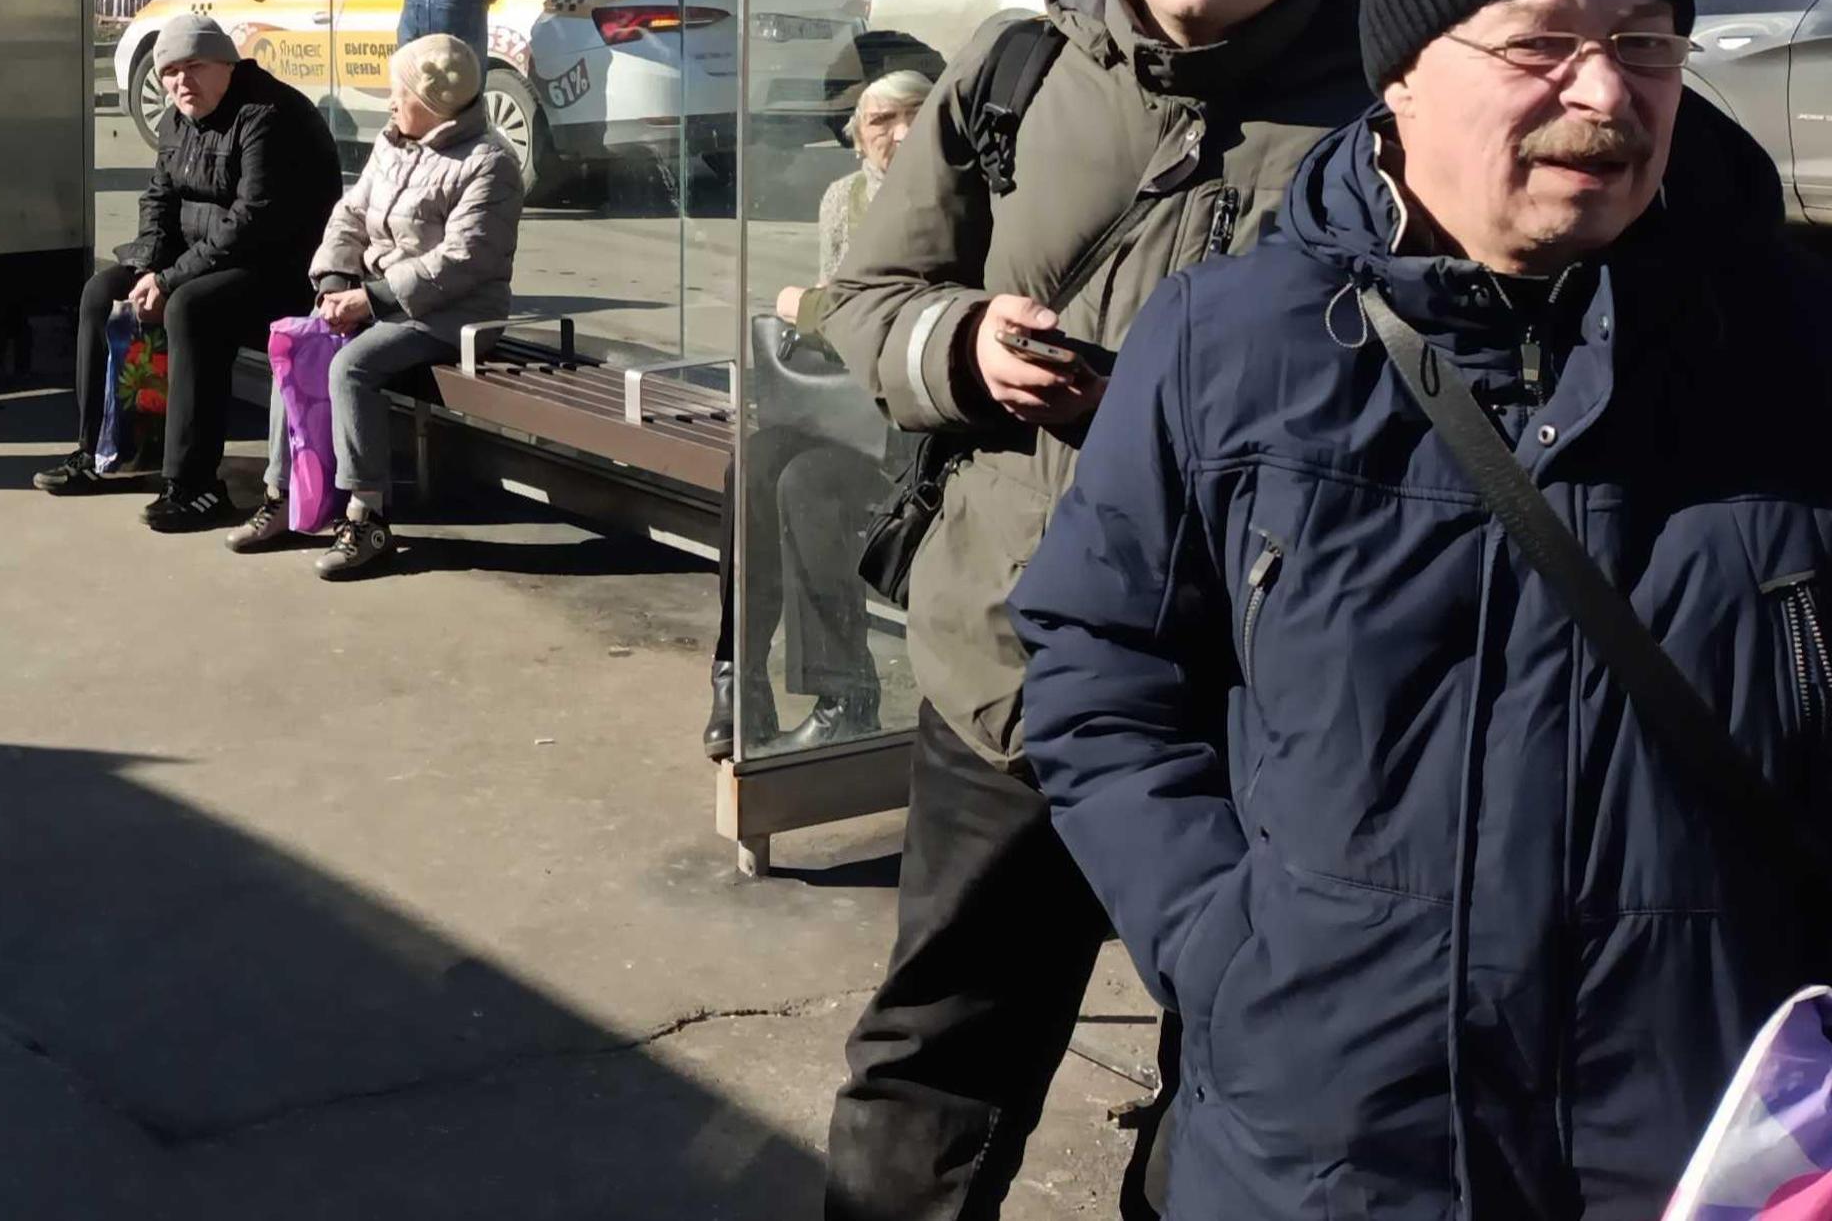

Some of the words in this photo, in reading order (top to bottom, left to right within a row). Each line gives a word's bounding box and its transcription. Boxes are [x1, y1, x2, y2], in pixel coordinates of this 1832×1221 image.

[279, 39, 321, 59] Яндекс
[279, 59, 325, 78] Маркет
[548, 64, 588, 107] 61%
